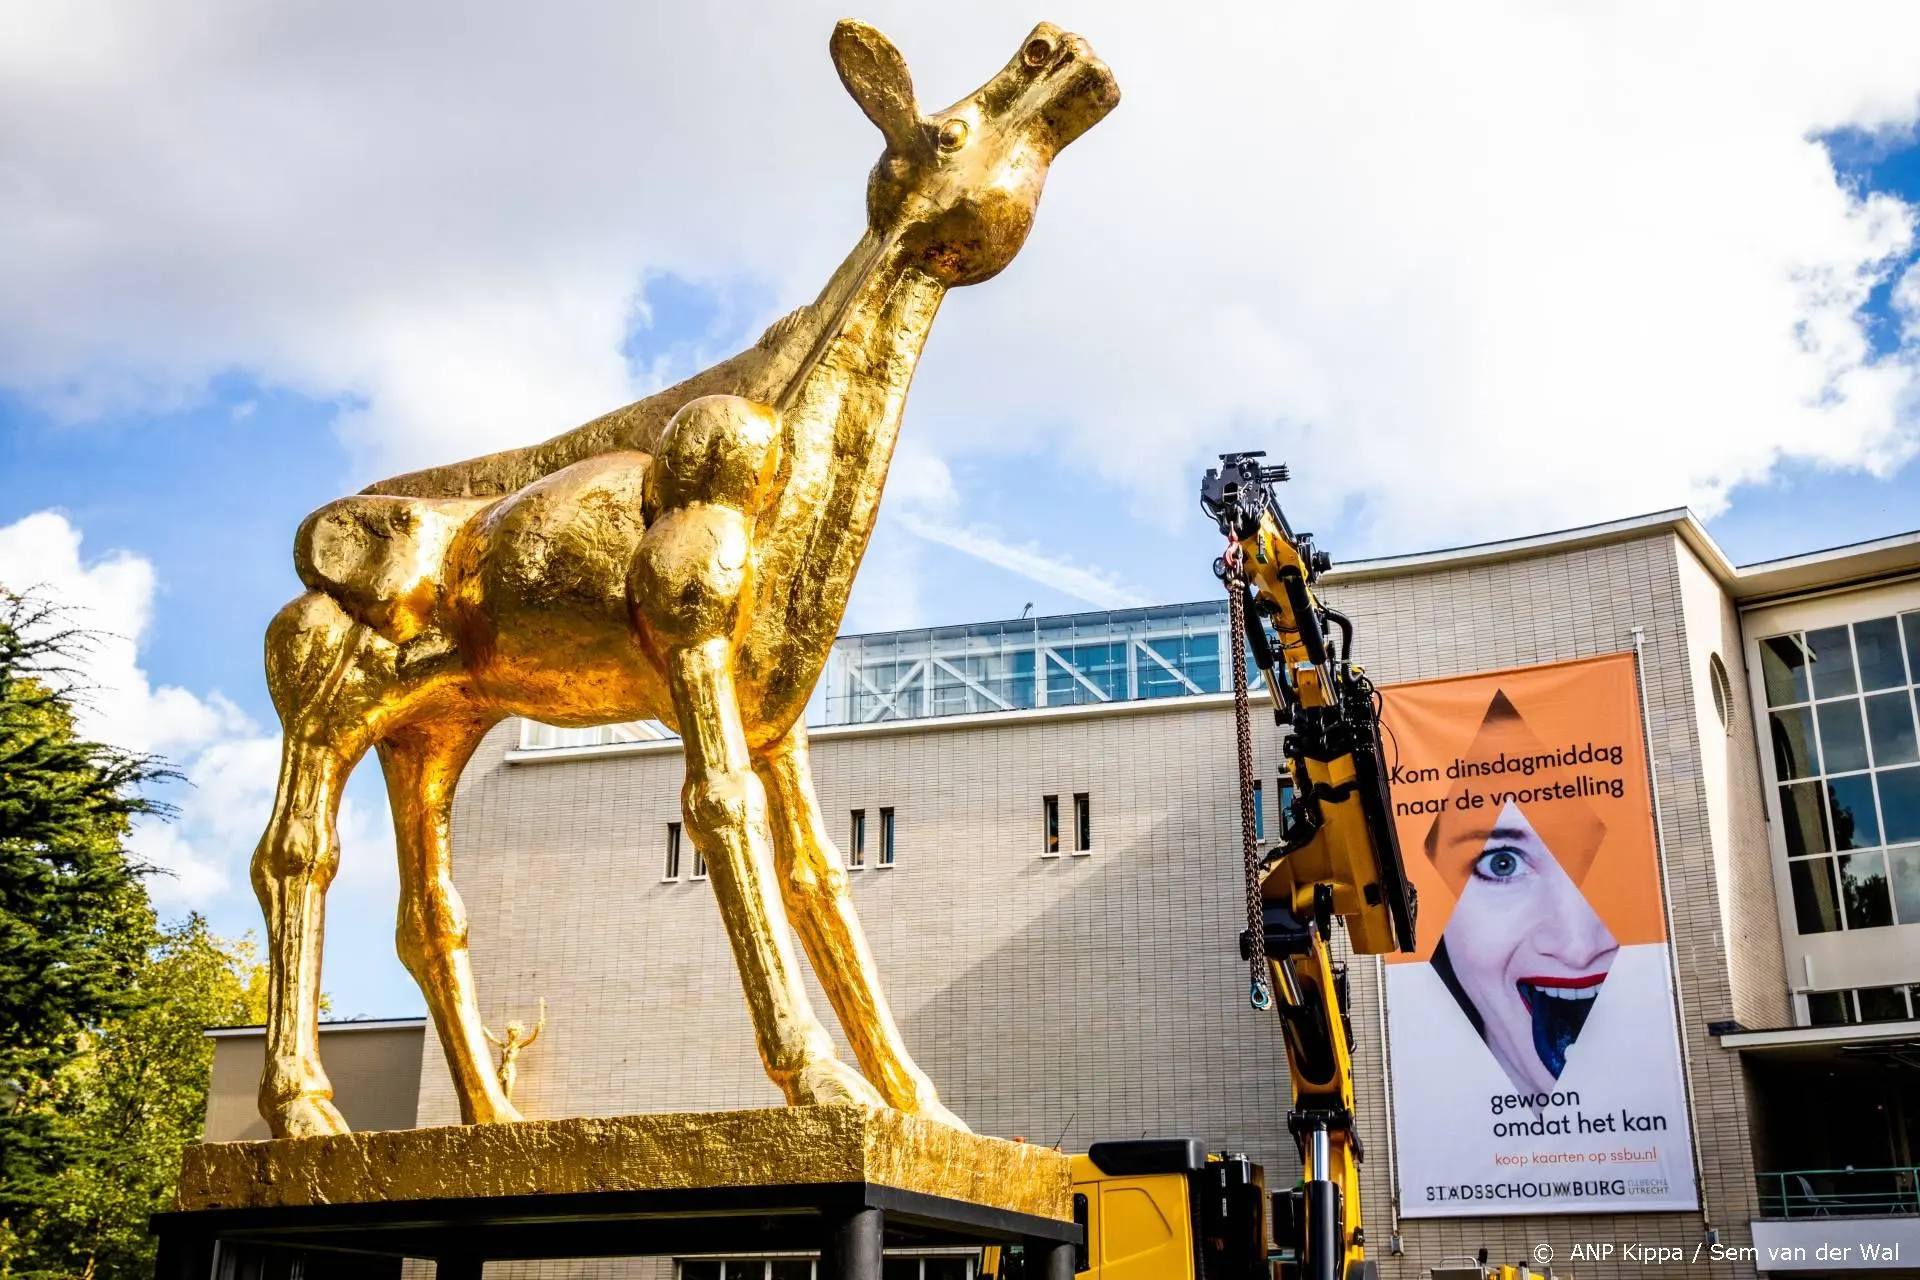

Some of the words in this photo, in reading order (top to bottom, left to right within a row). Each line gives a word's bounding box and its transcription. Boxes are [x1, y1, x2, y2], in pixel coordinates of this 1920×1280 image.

[1391, 765, 1440, 785] Kom
[1446, 742, 1623, 779] dinsdagmiddag
[1396, 798, 1449, 816] naar
[1455, 788, 1485, 810] de
[1490, 776, 1624, 806] voorstelling
[1491, 1090, 1580, 1115] gewoon
[1493, 1112, 1571, 1137] omdat
[1577, 1111, 1616, 1134] het
[1622, 1109, 1667, 1132] kan
[1495, 1153, 1528, 1167] koop
[1532, 1150, 1584, 1165] kaarten
[1588, 1151, 1607, 1165] op
[1610, 1147, 1657, 1162] ssbu.nl
[1426, 1179, 1625, 1200] STADSSCHOUWBURG
[1628, 1186, 1669, 1195] UTRECHT
